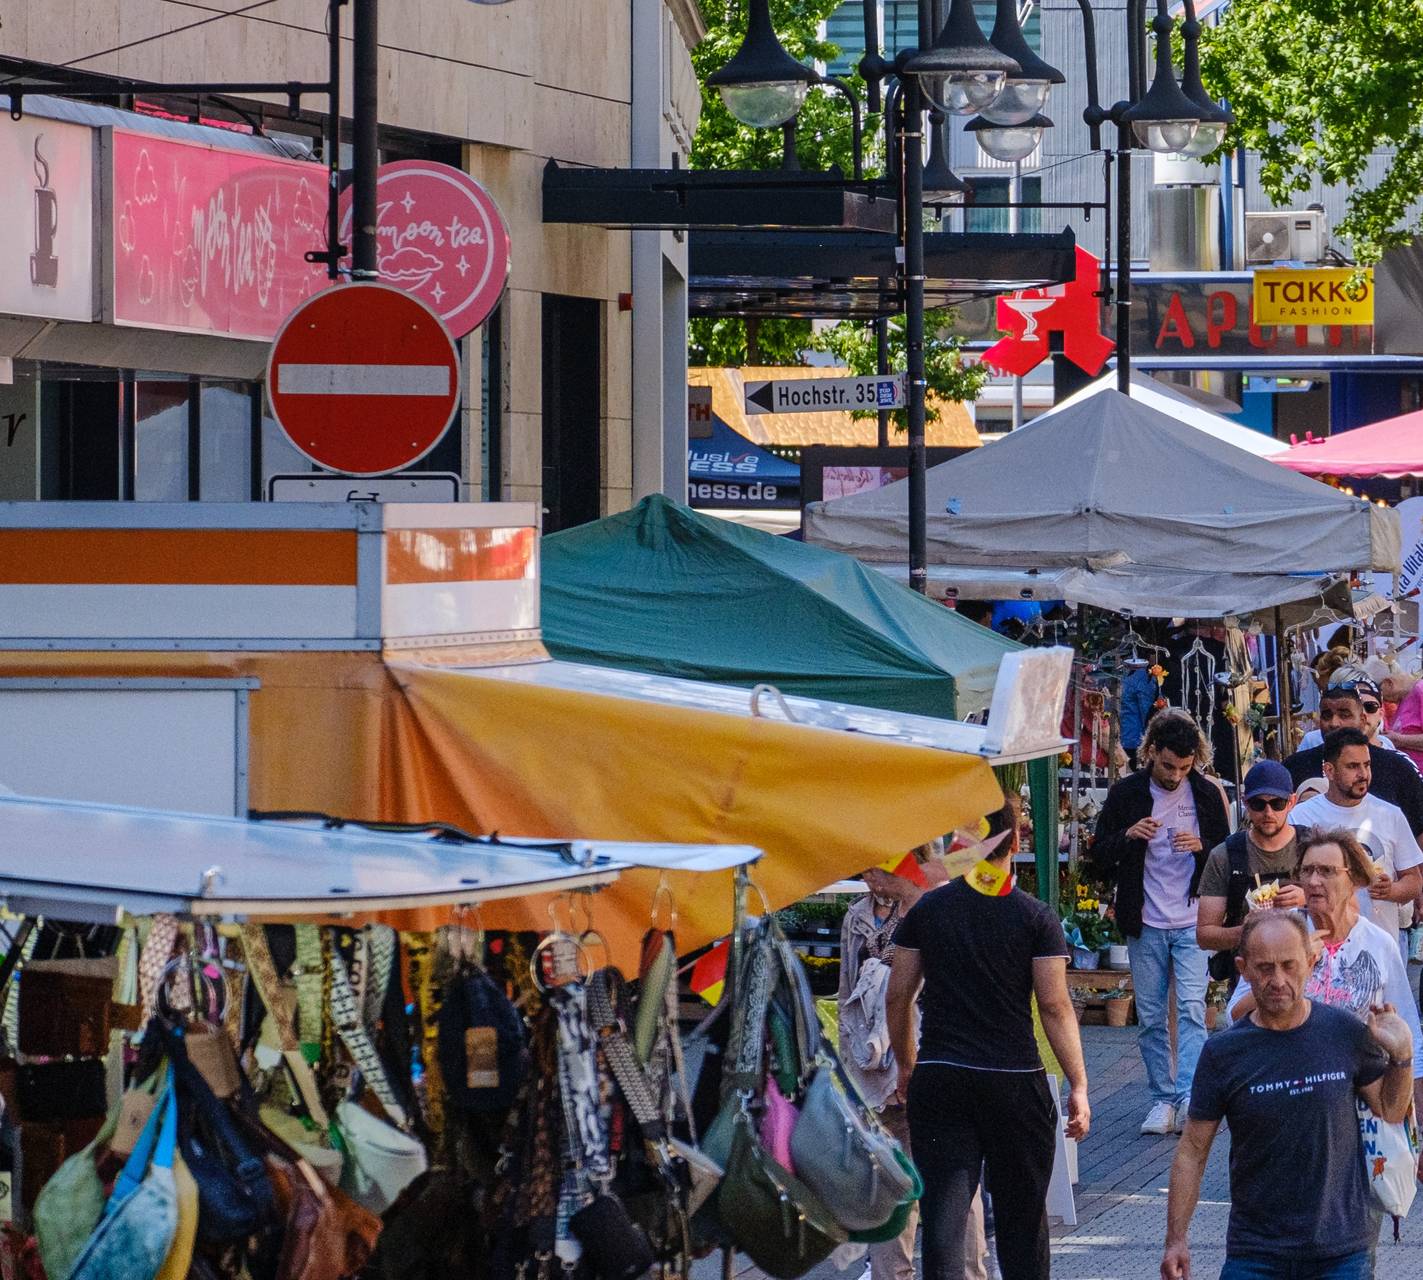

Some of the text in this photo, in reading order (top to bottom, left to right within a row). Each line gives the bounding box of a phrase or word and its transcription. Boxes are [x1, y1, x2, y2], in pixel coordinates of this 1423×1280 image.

[445, 215, 485, 248] tea
[1280, 307, 1352, 316] FASHION
[779, 384, 850, 406] Hochstr.
[1250, 1071, 1347, 1095] TOMMY HILFIGER
